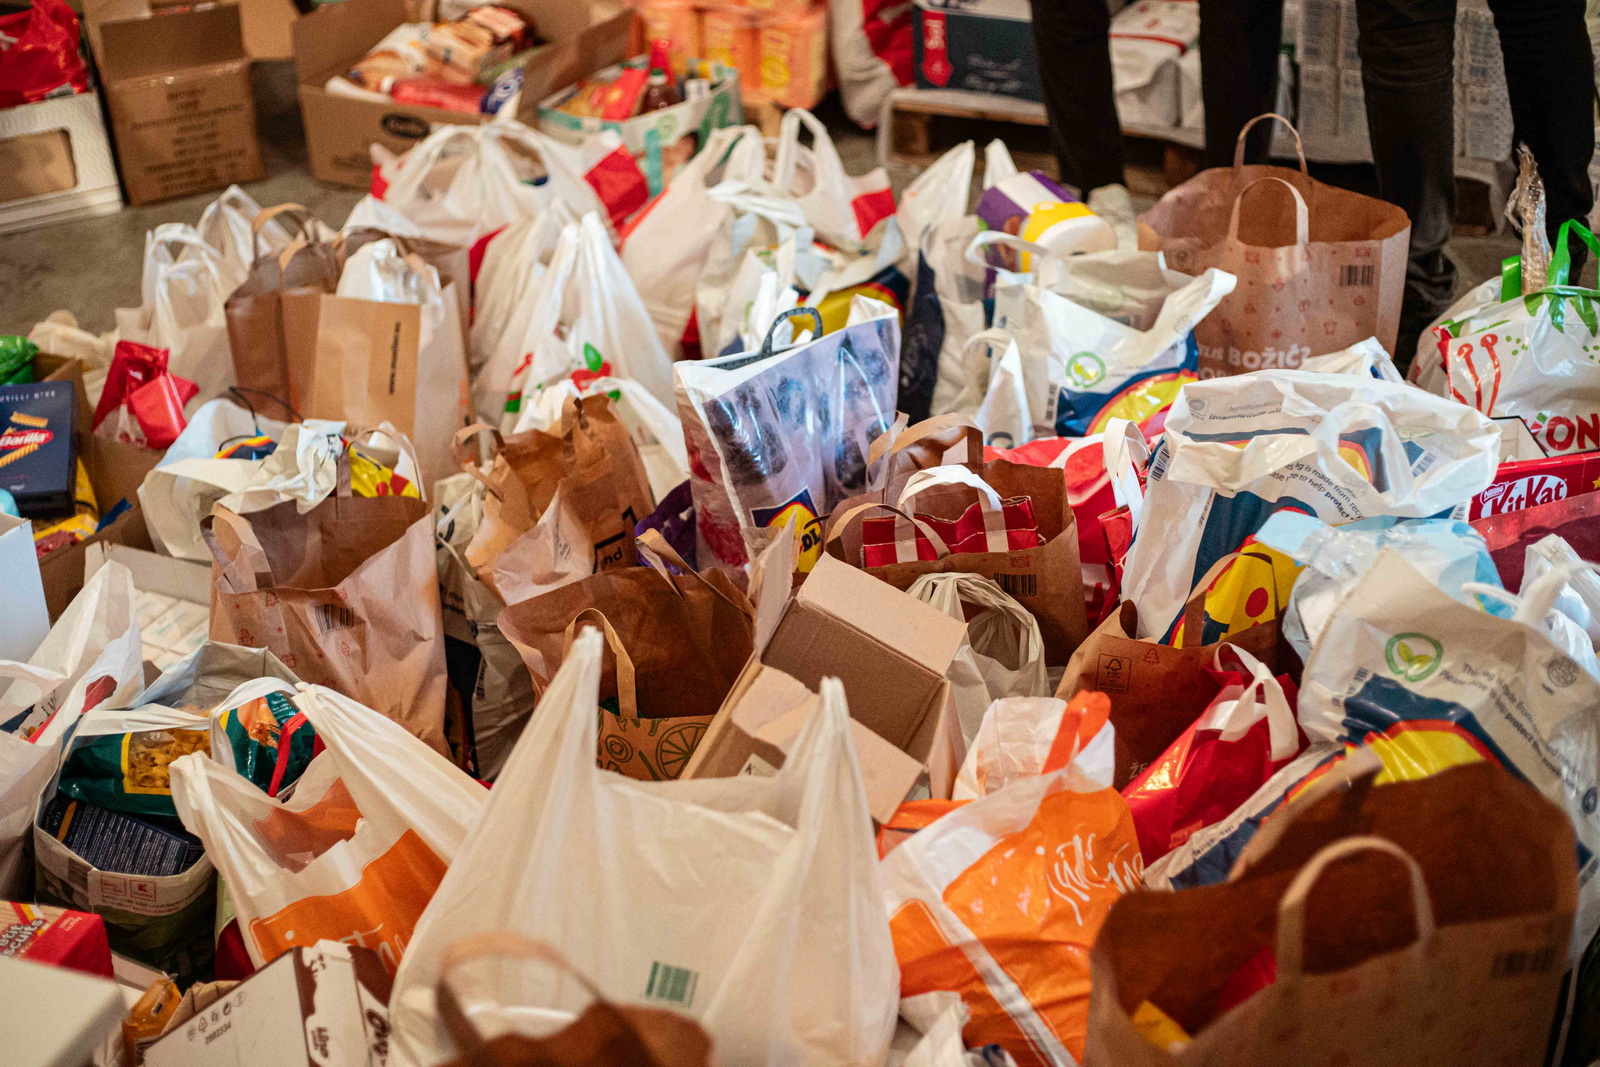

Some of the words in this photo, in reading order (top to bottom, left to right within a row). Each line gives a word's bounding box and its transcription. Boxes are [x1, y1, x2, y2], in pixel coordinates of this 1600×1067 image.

[1299, 474, 1308, 482] to
[1308, 478, 1326, 493] help
[1324, 491, 1350, 519] protect
[1304, 464, 1313, 472] is
[1311, 469, 1334, 487] made
[1333, 483, 1351, 503] from
[1491, 476, 1565, 516] KitKat
[1504, 712, 1535, 743] protect
